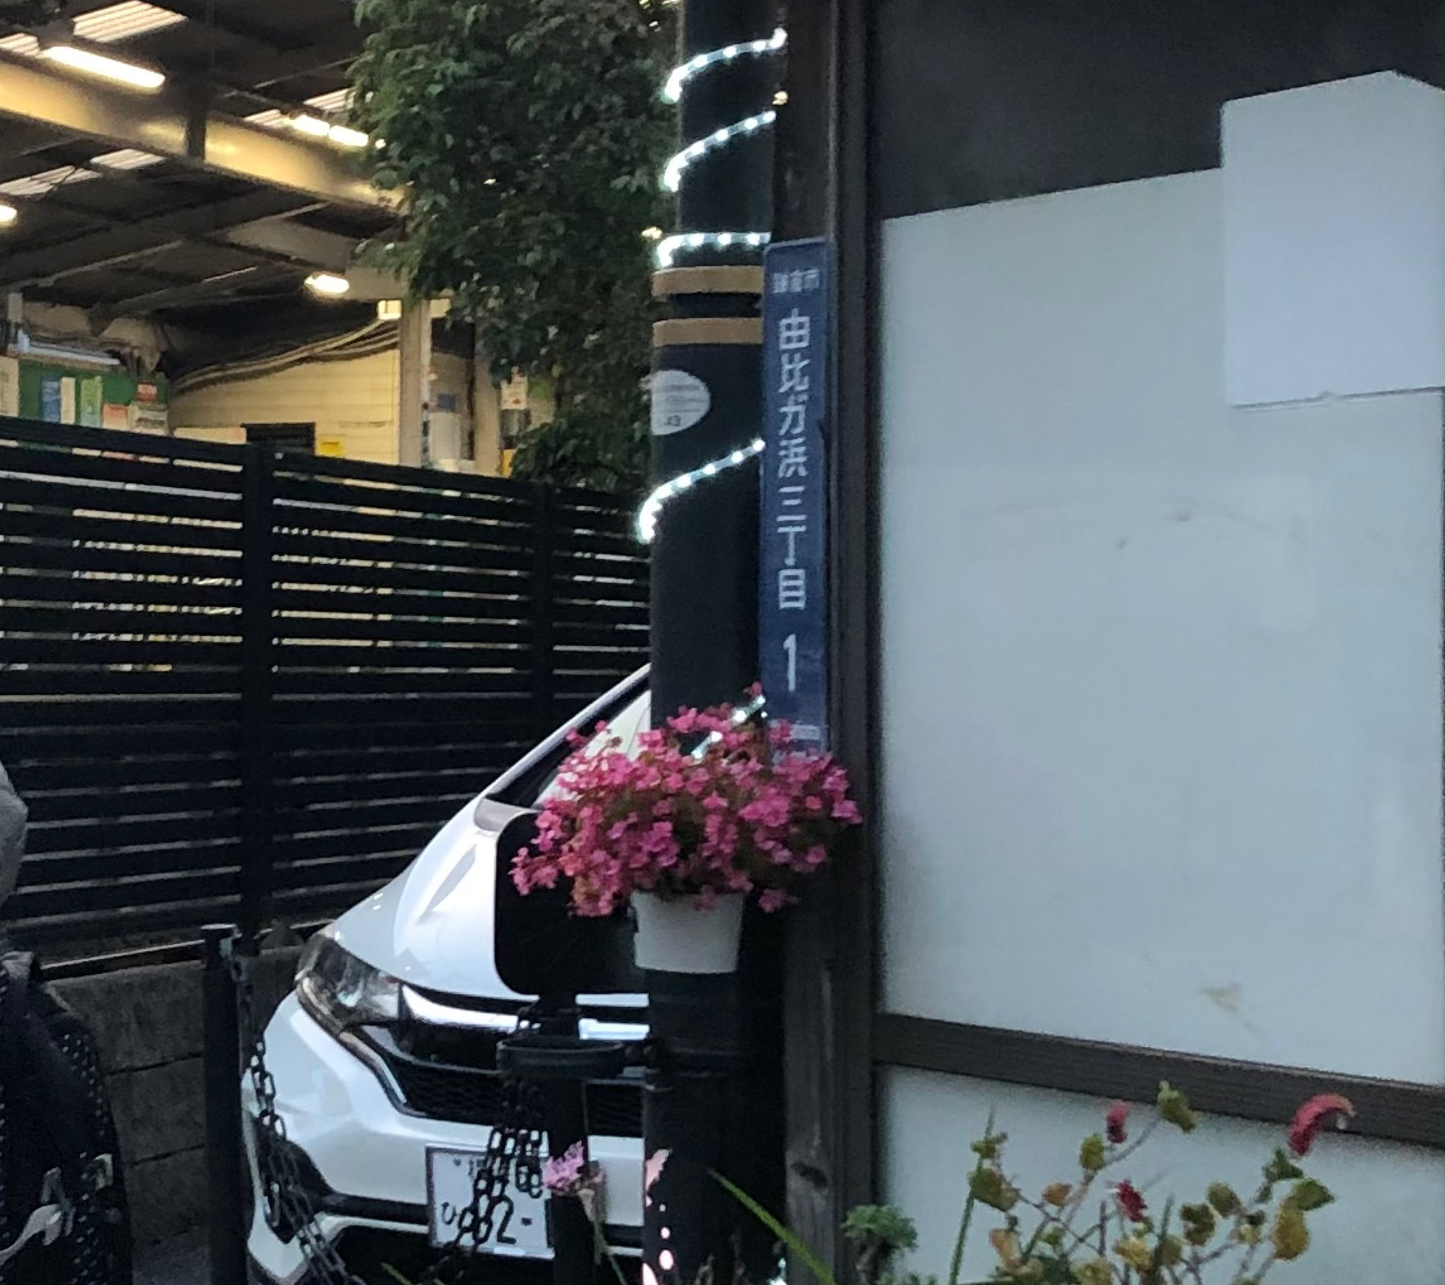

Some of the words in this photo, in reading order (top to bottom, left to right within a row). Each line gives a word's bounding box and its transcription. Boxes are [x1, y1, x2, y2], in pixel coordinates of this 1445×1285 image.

[778, 308, 811, 610] 由比ガ浜三丁目
[783, 634, 797, 693] 1
